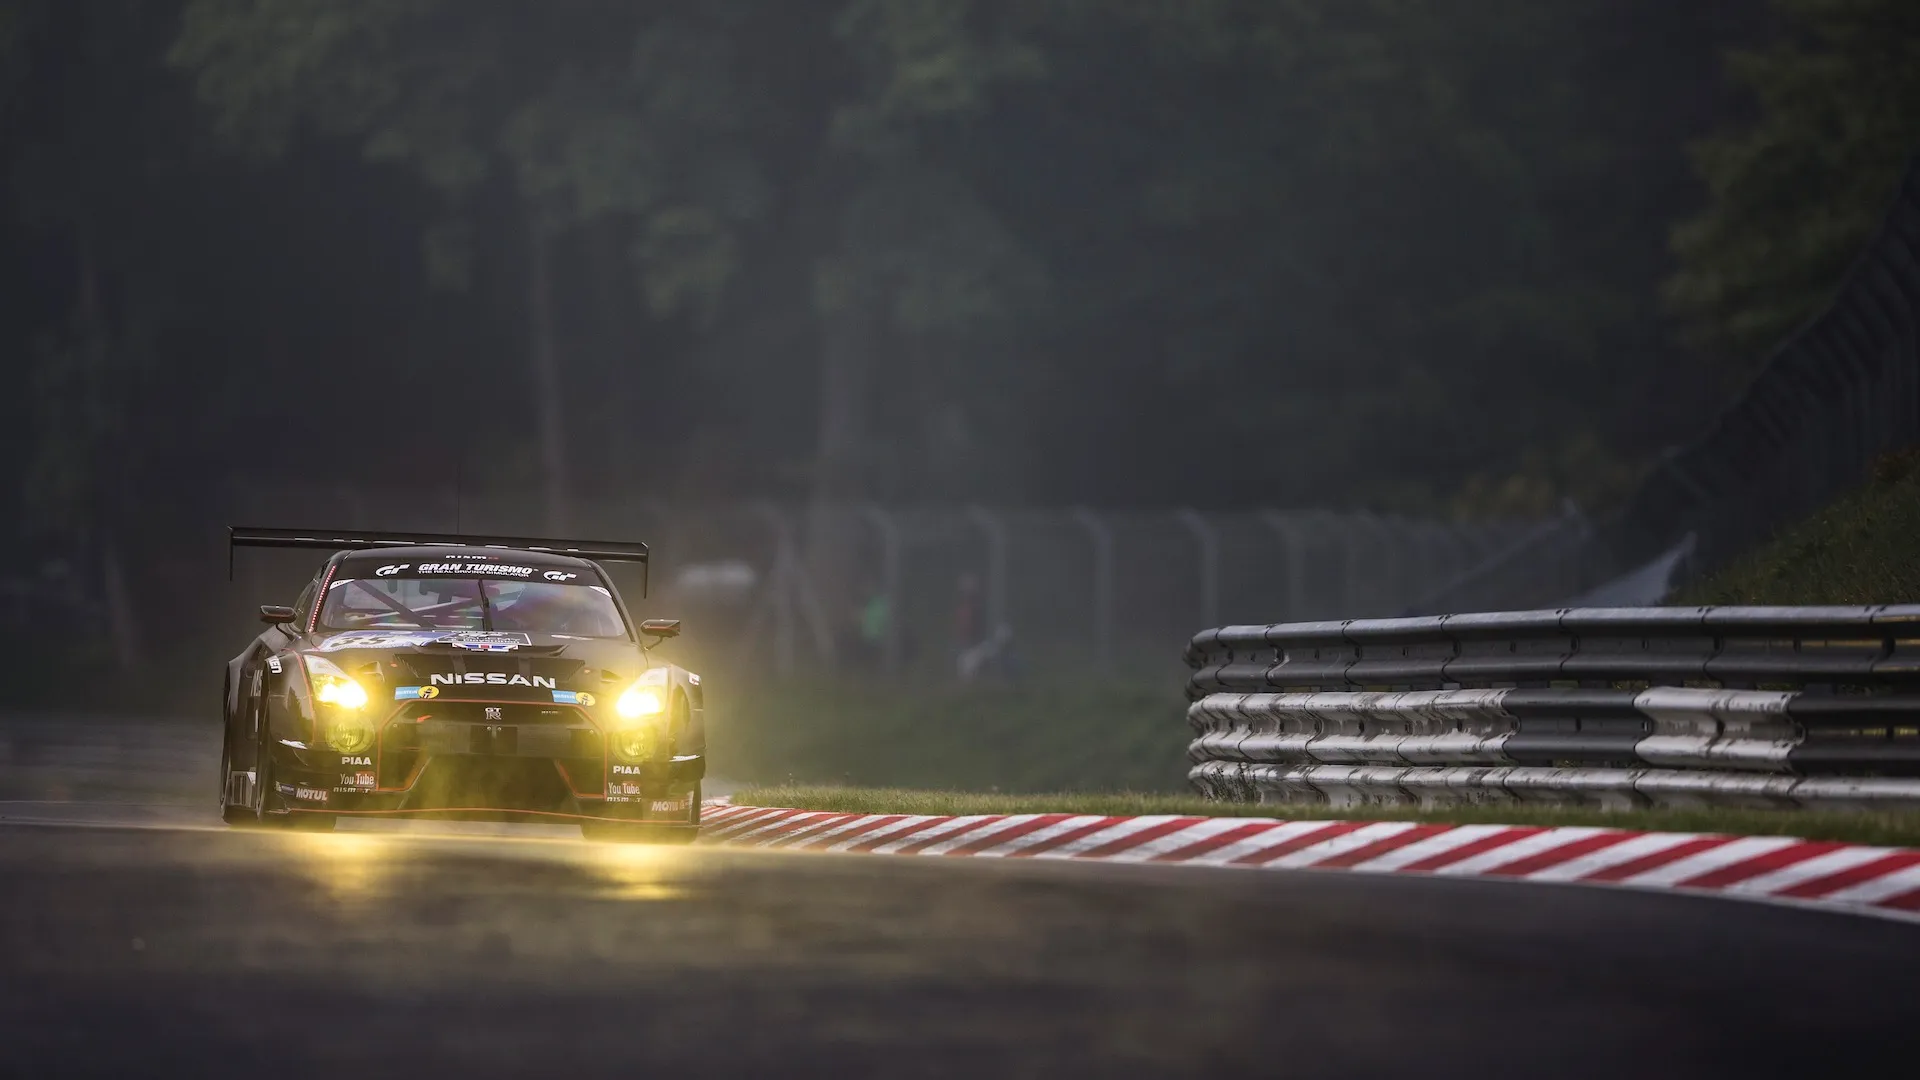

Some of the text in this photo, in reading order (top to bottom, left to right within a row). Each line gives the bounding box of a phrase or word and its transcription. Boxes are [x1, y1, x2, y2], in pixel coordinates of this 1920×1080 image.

[418, 563, 533, 575] GRAN TURISMO
[430, 672, 556, 689] NISSAN
[341, 756, 372, 765] PIAA
[613, 765, 641, 775] PIAA
[295, 788, 328, 801] MOTUL
